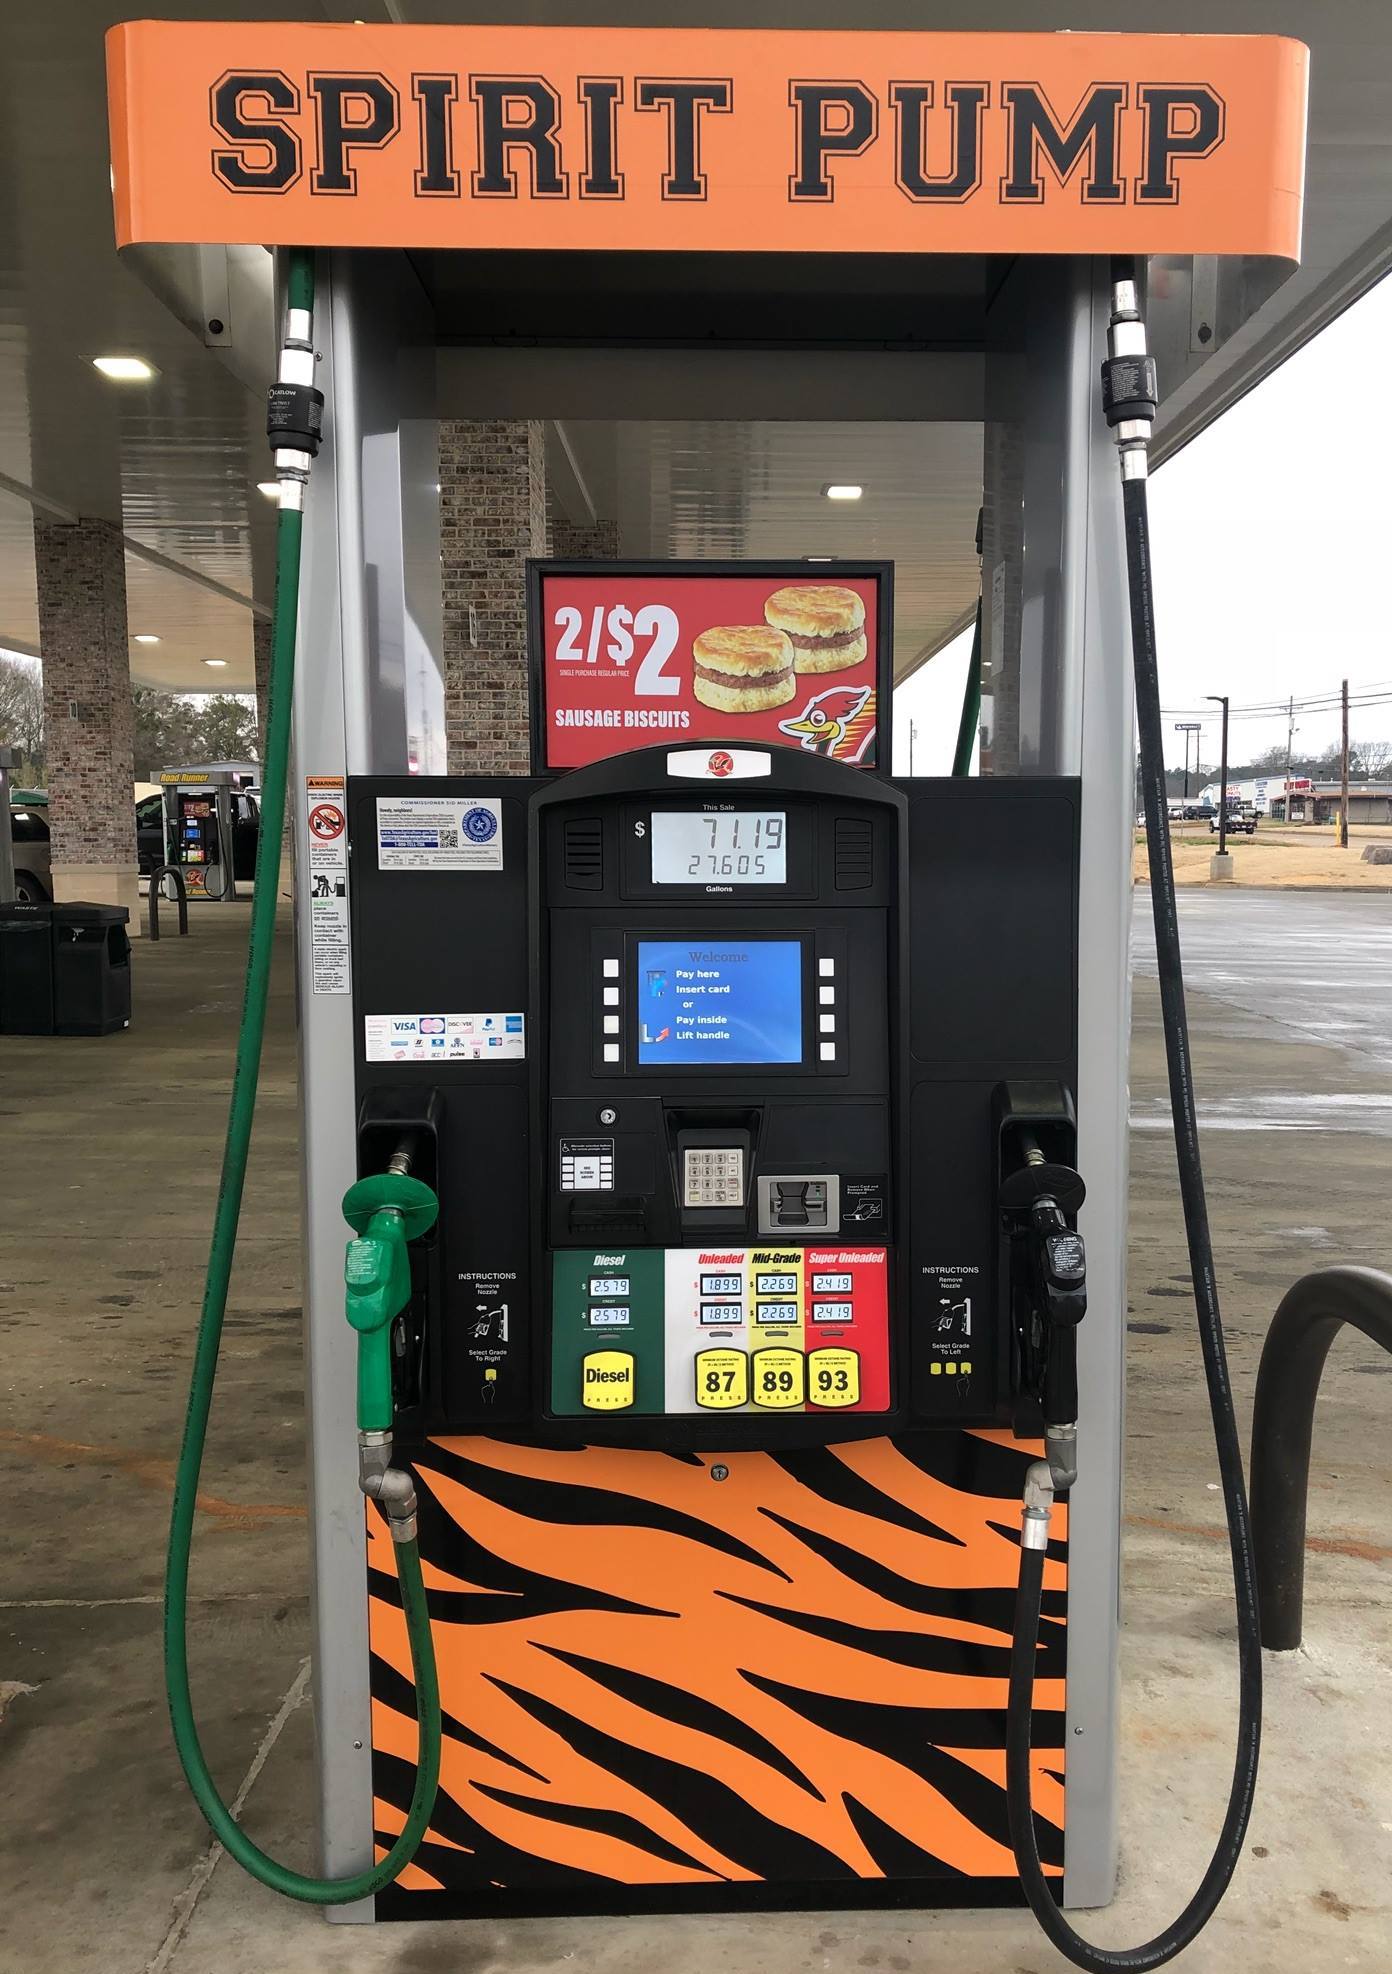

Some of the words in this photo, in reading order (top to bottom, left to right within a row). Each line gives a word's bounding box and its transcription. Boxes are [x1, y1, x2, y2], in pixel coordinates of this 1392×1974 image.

[209, 68, 733, 201] SPIRIT
[788, 78, 1226, 205] PUMP
[559, 669, 574, 677] SINGLE
[555, 709, 621, 726] SAUSAGE
[624, 710, 689, 728] BISCUITS
[160, 773, 179, 782] Road
[181, 774, 208, 782] Runner
[634, 821, 645, 838] $
[702, 818, 783, 849] 71.19
[688, 855, 765, 875] 27.605
[688, 952, 749, 963] Welcome
[676, 970, 694, 980] Pay
[697, 970, 720, 978] here
[676, 985, 706, 993] Insert
[708, 985, 730, 993] card
[393, 1022, 415, 1031] VISA
[676, 1016, 694, 1026] Pay
[697, 1016, 727, 1024] inside
[676, 1031, 694, 1039] Lift
[696, 1031, 730, 1039] handle
[593, 1255, 626, 1266] Diesel
[698, 1254, 744, 1264] Unleaded
[752, 1253, 801, 1264] Mid-Grade
[809, 1253, 838, 1264] Super
[839, 1252, 884, 1263] Unleaded
[595, 1281, 627, 1292] 2.579
[710, 1279, 738, 1290] 1.899
[762, 1278, 794, 1290] 2.269
[817, 1278, 849, 1289] 2.419
[595, 1310, 627, 1321] 2.579
[710, 1308, 738, 1319] 1.899
[762, 1307, 794, 1319] 2.269
[817, 1307, 850, 1318] 2.419
[586, 1368, 629, 1383] Diesel
[818, 1370, 848, 1391] 93
[706, 1371, 736, 1392] 87
[763, 1371, 793, 1392] 89
